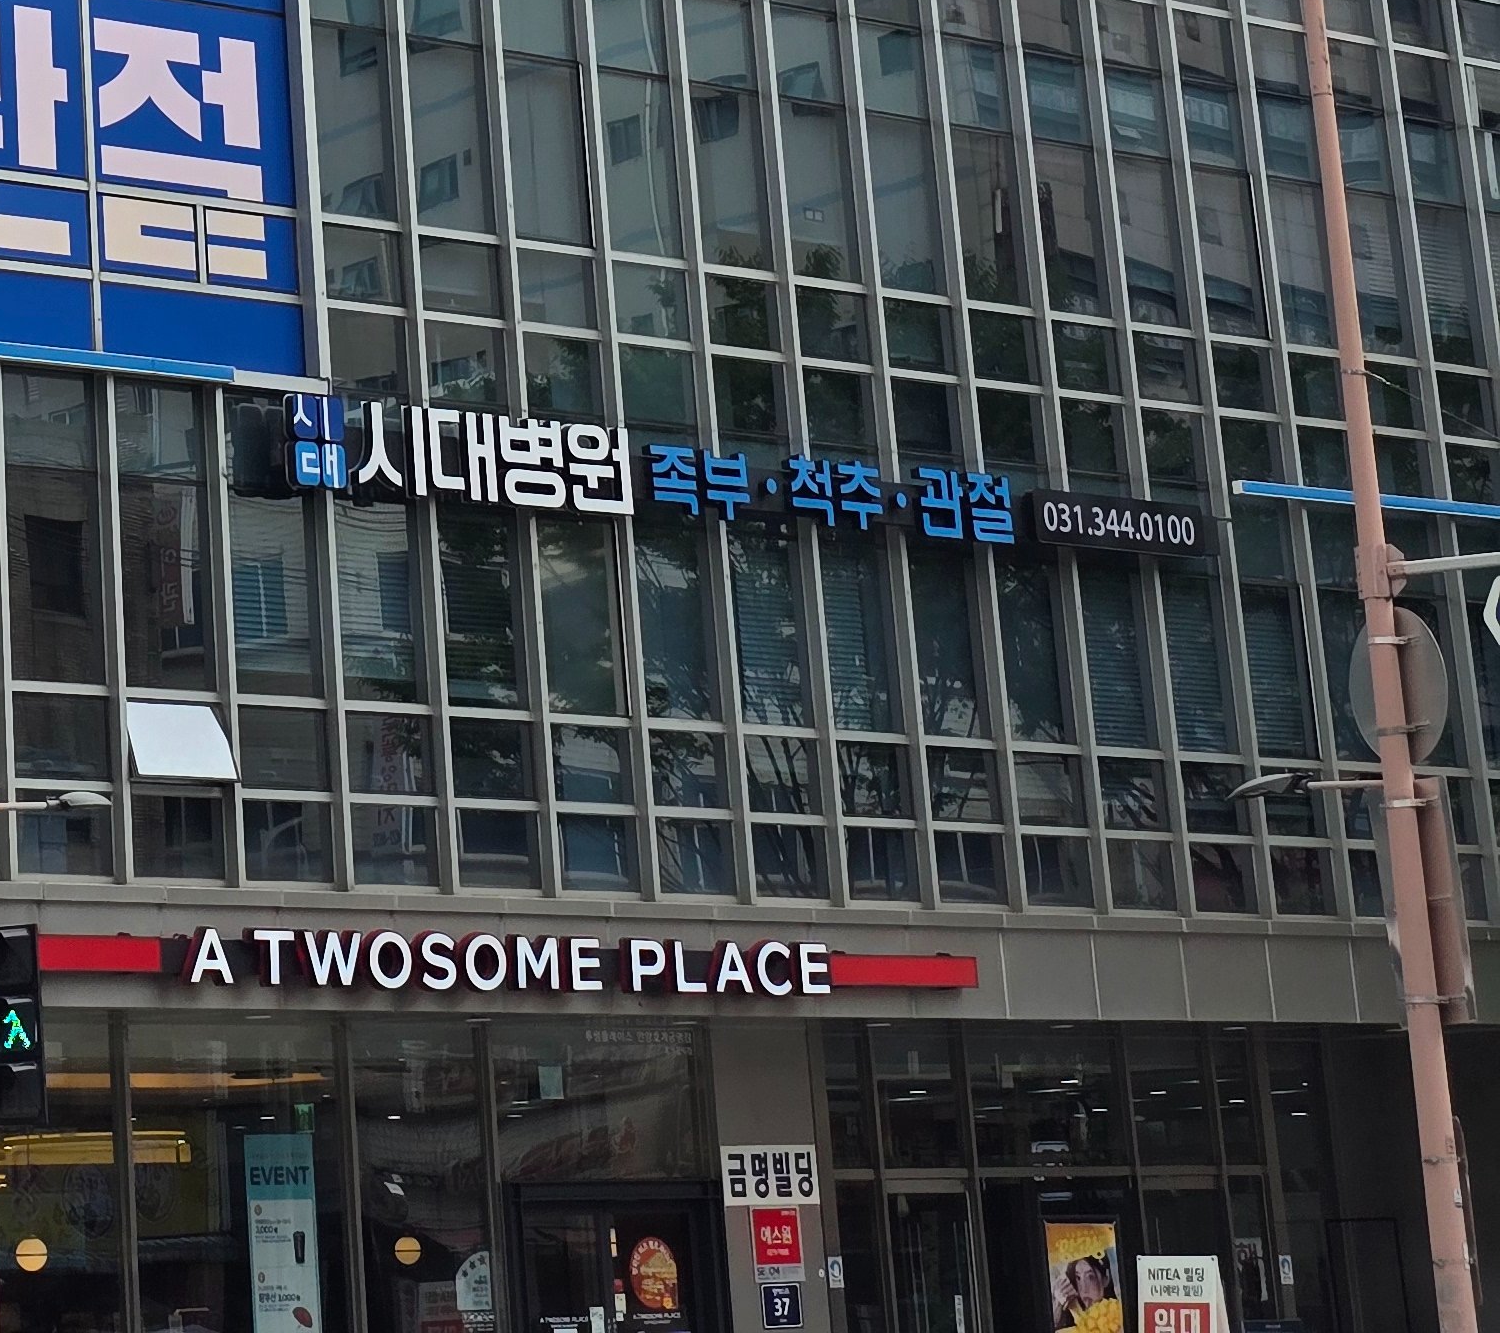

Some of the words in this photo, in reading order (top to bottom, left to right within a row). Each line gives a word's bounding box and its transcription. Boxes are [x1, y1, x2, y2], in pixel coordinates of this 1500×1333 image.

[292, 394, 342, 489] 시대
[358, 403, 634, 515] 시대병원
[1043, 499, 1196, 547] 031.344.0100
[191, 928, 234, 984] A
[254, 930, 603, 991] TWOSOME
[630, 939, 831, 996] PLACE
[250, 1166, 309, 1185] EVENT
[728, 1152, 814, 1198] 금명빌딩
[773, 1297, 791, 1317] 37
